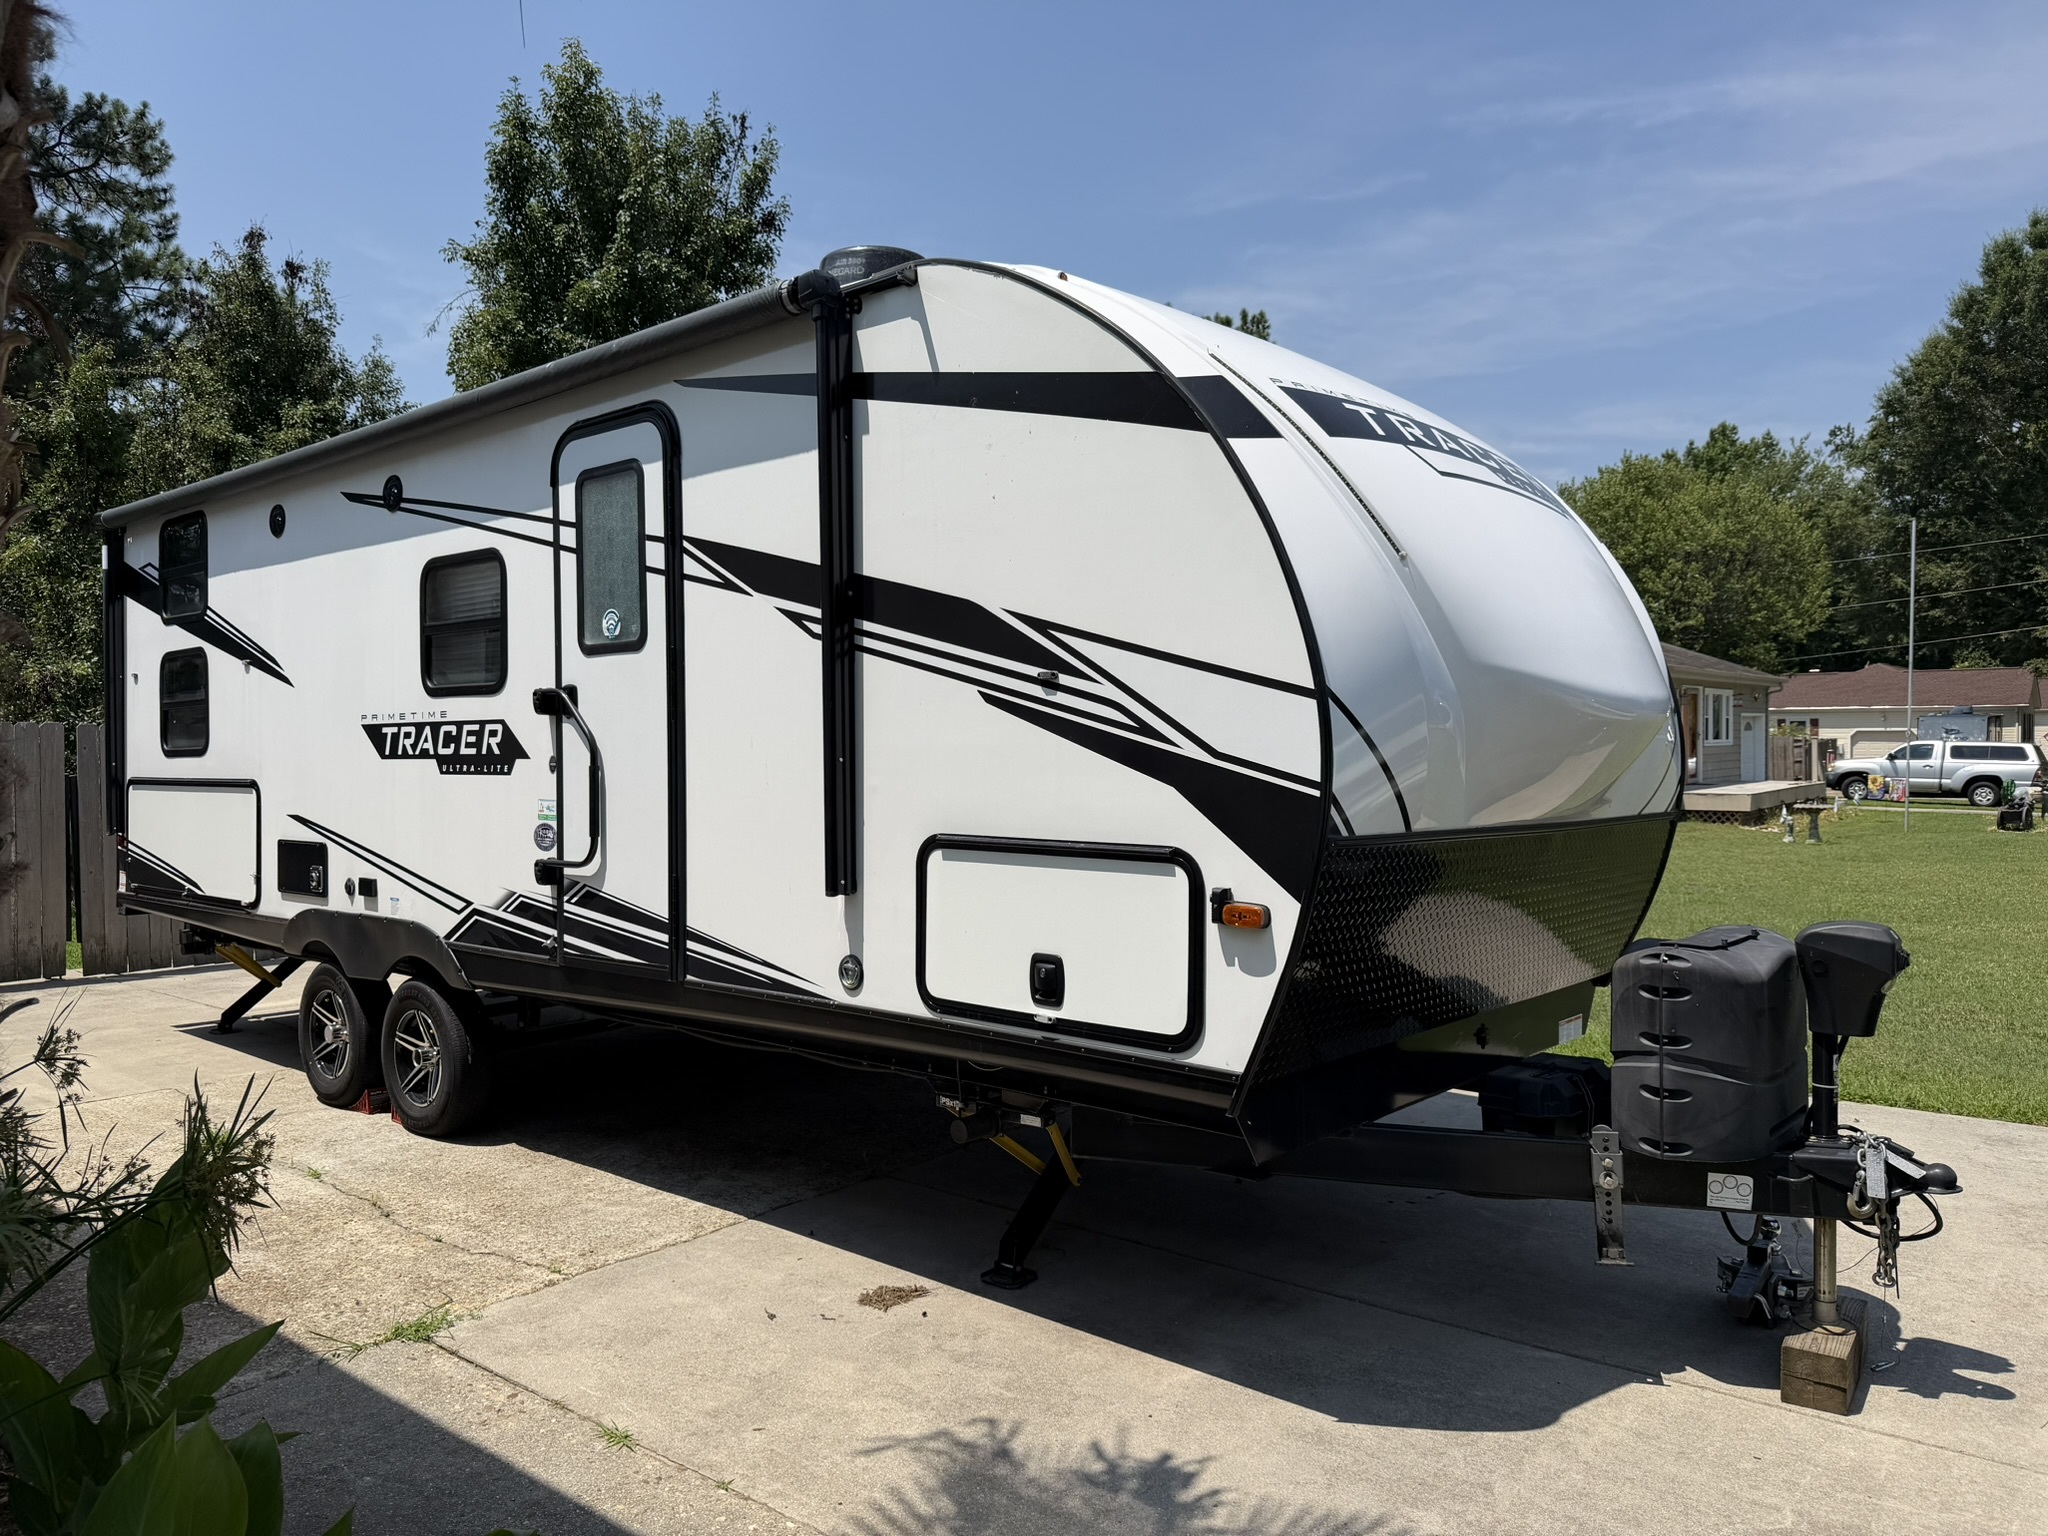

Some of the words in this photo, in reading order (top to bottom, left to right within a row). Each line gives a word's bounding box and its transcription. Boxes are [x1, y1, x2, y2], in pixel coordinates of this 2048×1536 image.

[1342, 402, 1554, 503] TRACER
[361, 710, 448, 722] PRIMETIME
[381, 723, 503, 756] TRACER
[442, 764, 509, 773] ULTRA-LITE
